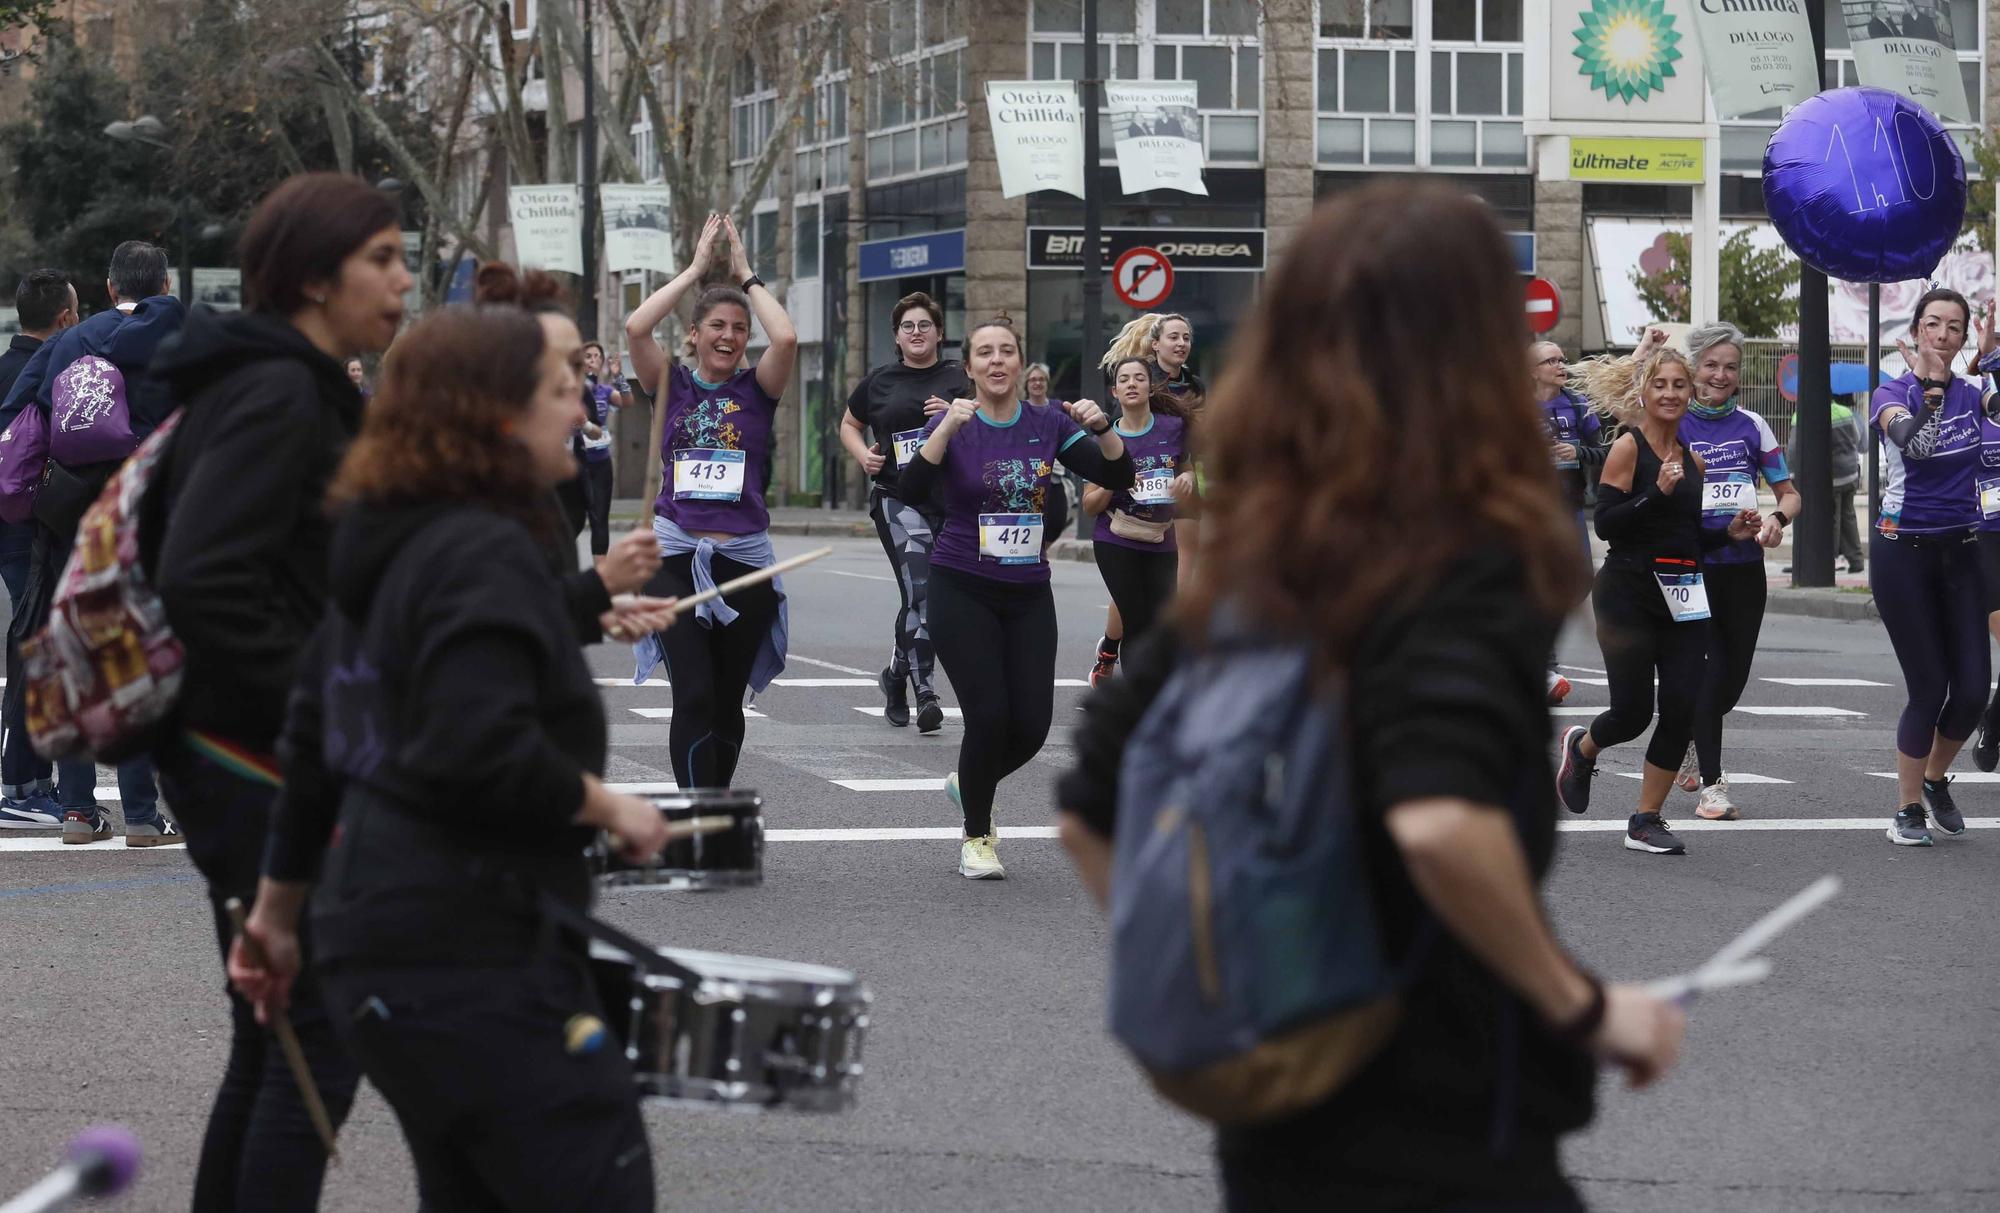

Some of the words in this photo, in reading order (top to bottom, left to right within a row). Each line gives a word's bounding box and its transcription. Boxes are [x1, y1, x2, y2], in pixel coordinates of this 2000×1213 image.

[1729, 29, 1794, 44] DIÁLOGO
[1884, 42, 1942, 57] DIÁLOGO
[1002, 90, 1066, 105] Oteiza
[999, 108, 1075, 124] Chillida
[1573, 153, 1649, 170] ultimate
[516, 206, 576, 219] Chillida
[1156, 244, 1252, 257] ORBEA
[690, 463, 727, 480] 413
[1712, 484, 1742, 499] 367
[998, 528, 1031, 544] 412
